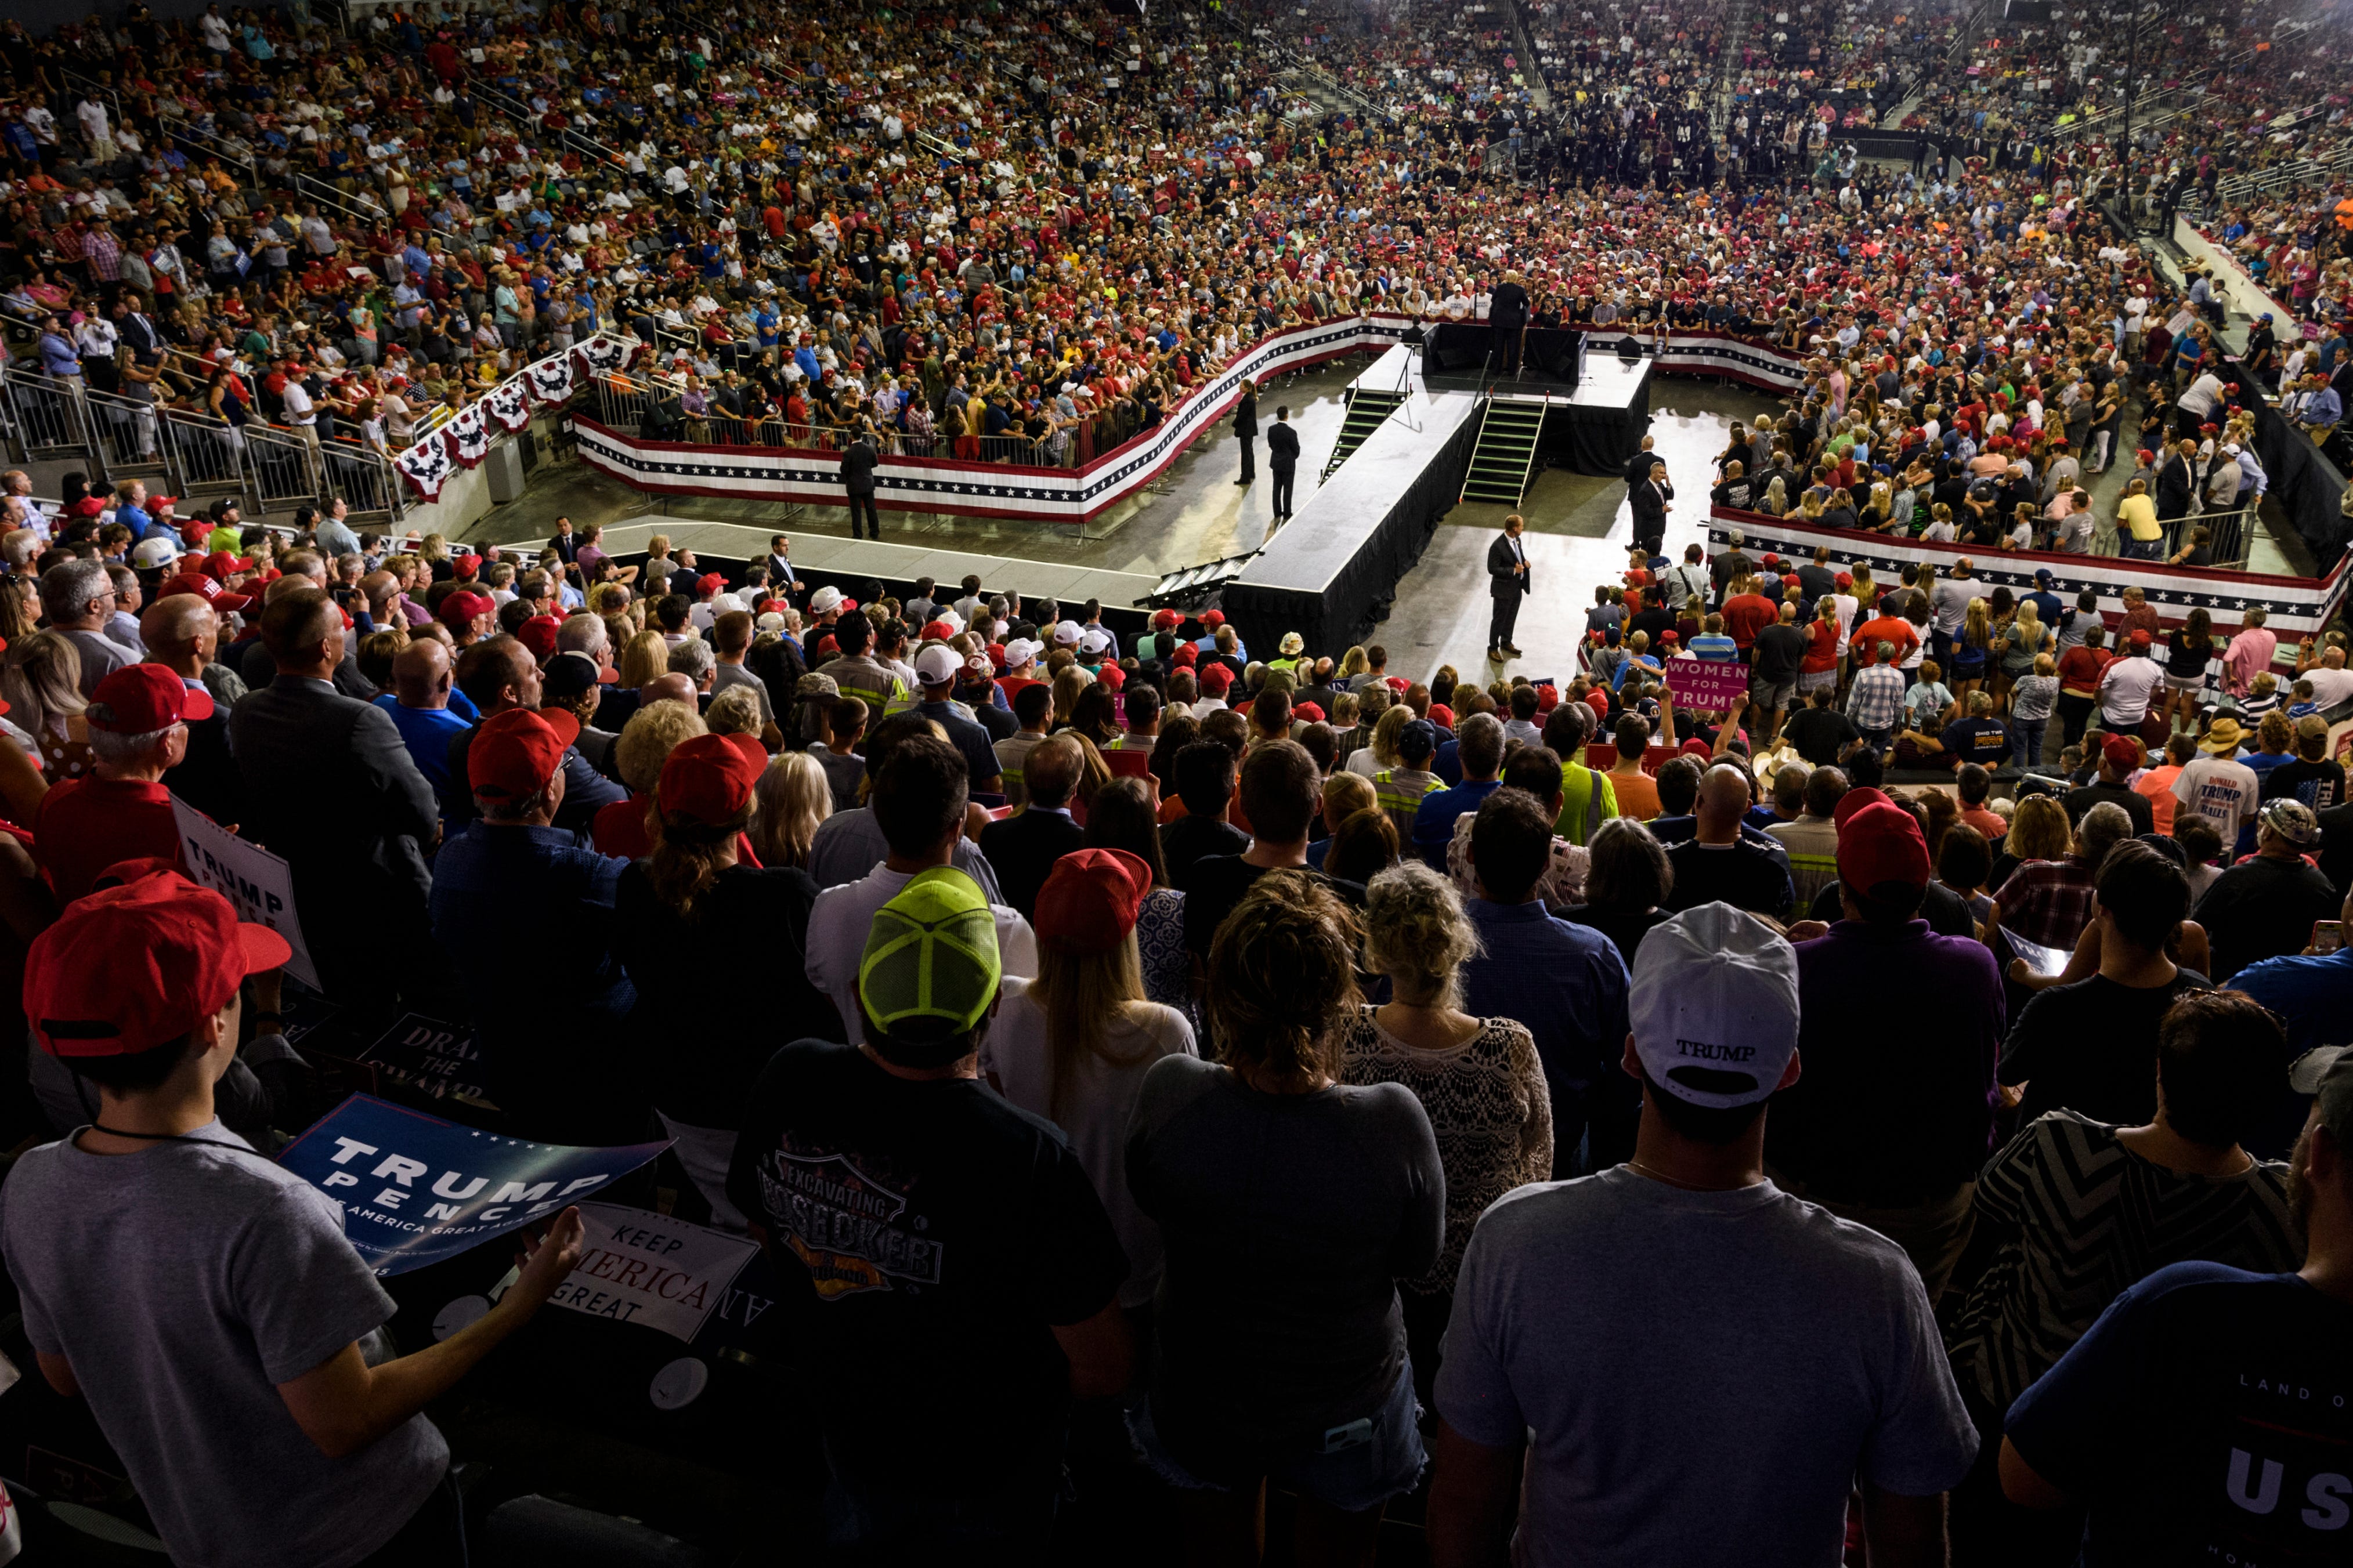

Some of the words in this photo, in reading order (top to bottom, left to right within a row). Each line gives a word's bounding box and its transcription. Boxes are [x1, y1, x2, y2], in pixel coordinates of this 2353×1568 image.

[1668, 661, 1748, 679] WOMEN
[1691, 679, 1720, 690] FOR
[2201, 785, 2241, 801] TRUMP
[2209, 776, 2238, 788] DONALD
[2201, 804, 2227, 819] BALLS
[187, 836, 283, 914] TRUMP
[202, 868, 276, 930] PENCE
[420, 1055, 461, 1075] THE
[1677, 1040, 1755, 1061] TRUMP
[330, 1135, 609, 1203] TRUMP
[322, 1170, 561, 1221] PENCE
[787, 1165, 885, 1218] EXCAVATING
[347, 1205, 425, 1233] AMERICA
[431, 1225, 487, 1235] GREAT
[612, 1225, 683, 1255] KEEP
[551, 1283, 642, 1322] GREAT
[2239, 1373, 2311, 1400] LAND
[2332, 1395, 2345, 1408] O
[2226, 1446, 2353, 1531] US
